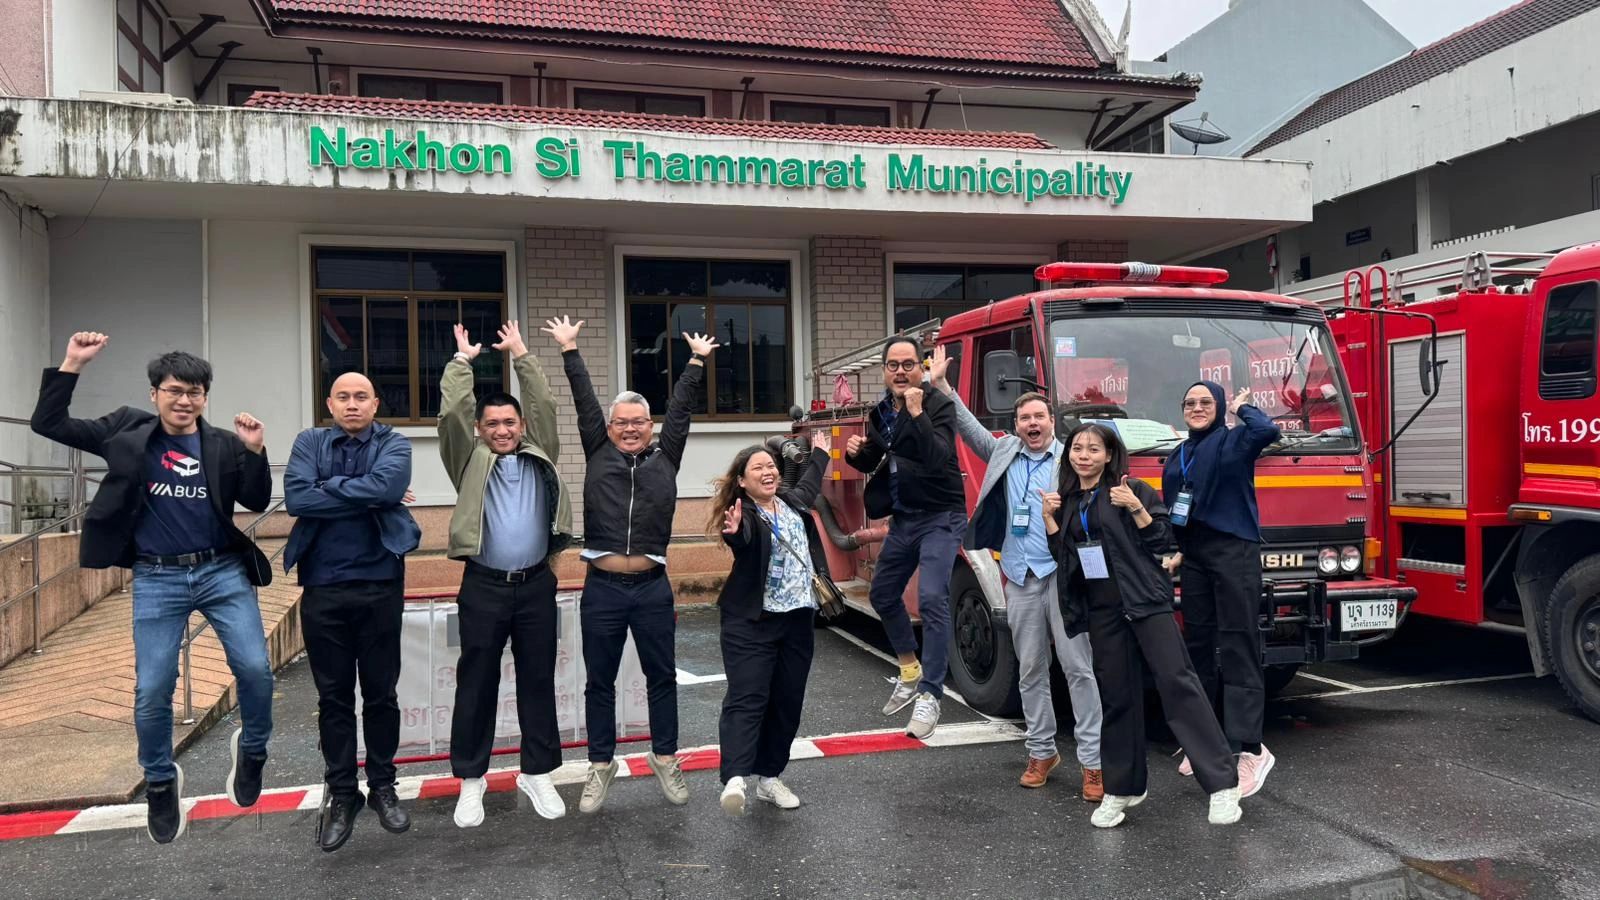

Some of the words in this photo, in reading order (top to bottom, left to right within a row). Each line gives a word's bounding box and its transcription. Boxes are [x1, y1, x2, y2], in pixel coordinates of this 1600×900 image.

[310, 126, 513, 175] Nakhon
[535, 137, 581, 179] Si
[603, 140, 866, 189] Thammarat
[888, 153, 1133, 205] Municipality
[1369, 603, 1395, 618] 1139
